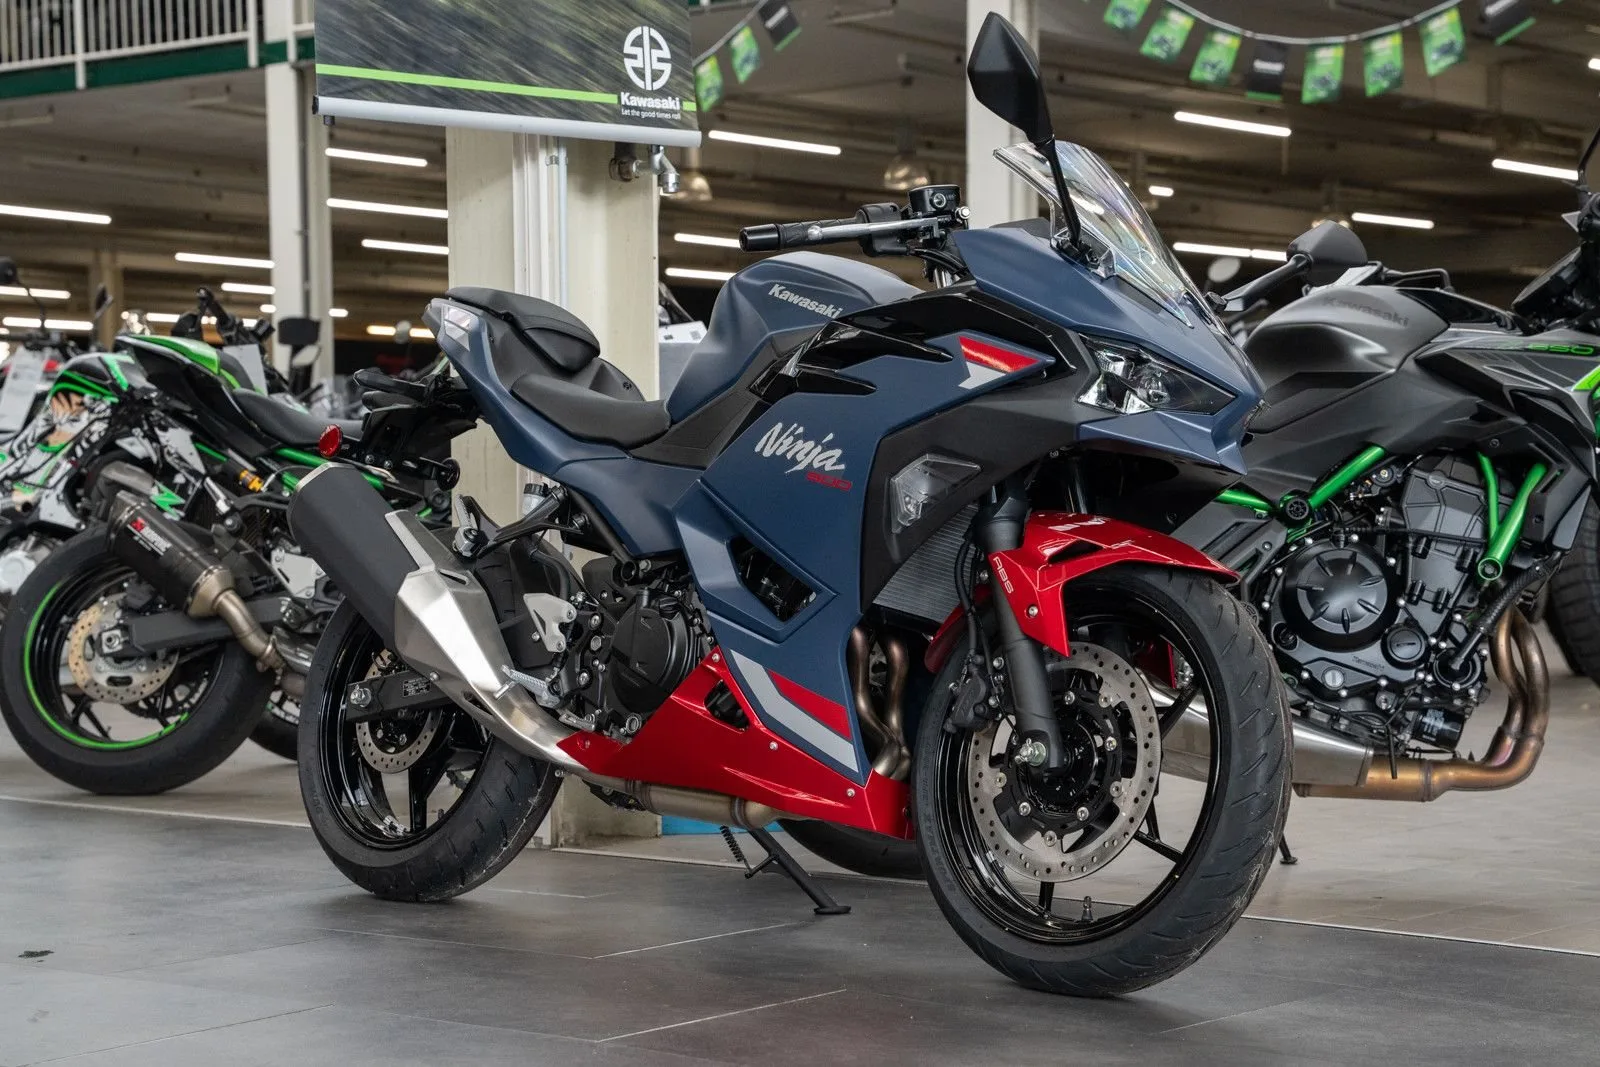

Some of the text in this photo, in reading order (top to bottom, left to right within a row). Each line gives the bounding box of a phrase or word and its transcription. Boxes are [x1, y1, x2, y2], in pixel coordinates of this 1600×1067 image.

[620, 92, 681, 110] Kawasaki
[768, 283, 844, 319] Kawasaki
[1323, 298, 1409, 327] Kawasaki
[754, 422, 846, 474] Ninja
[992, 556, 1014, 594] ABS
